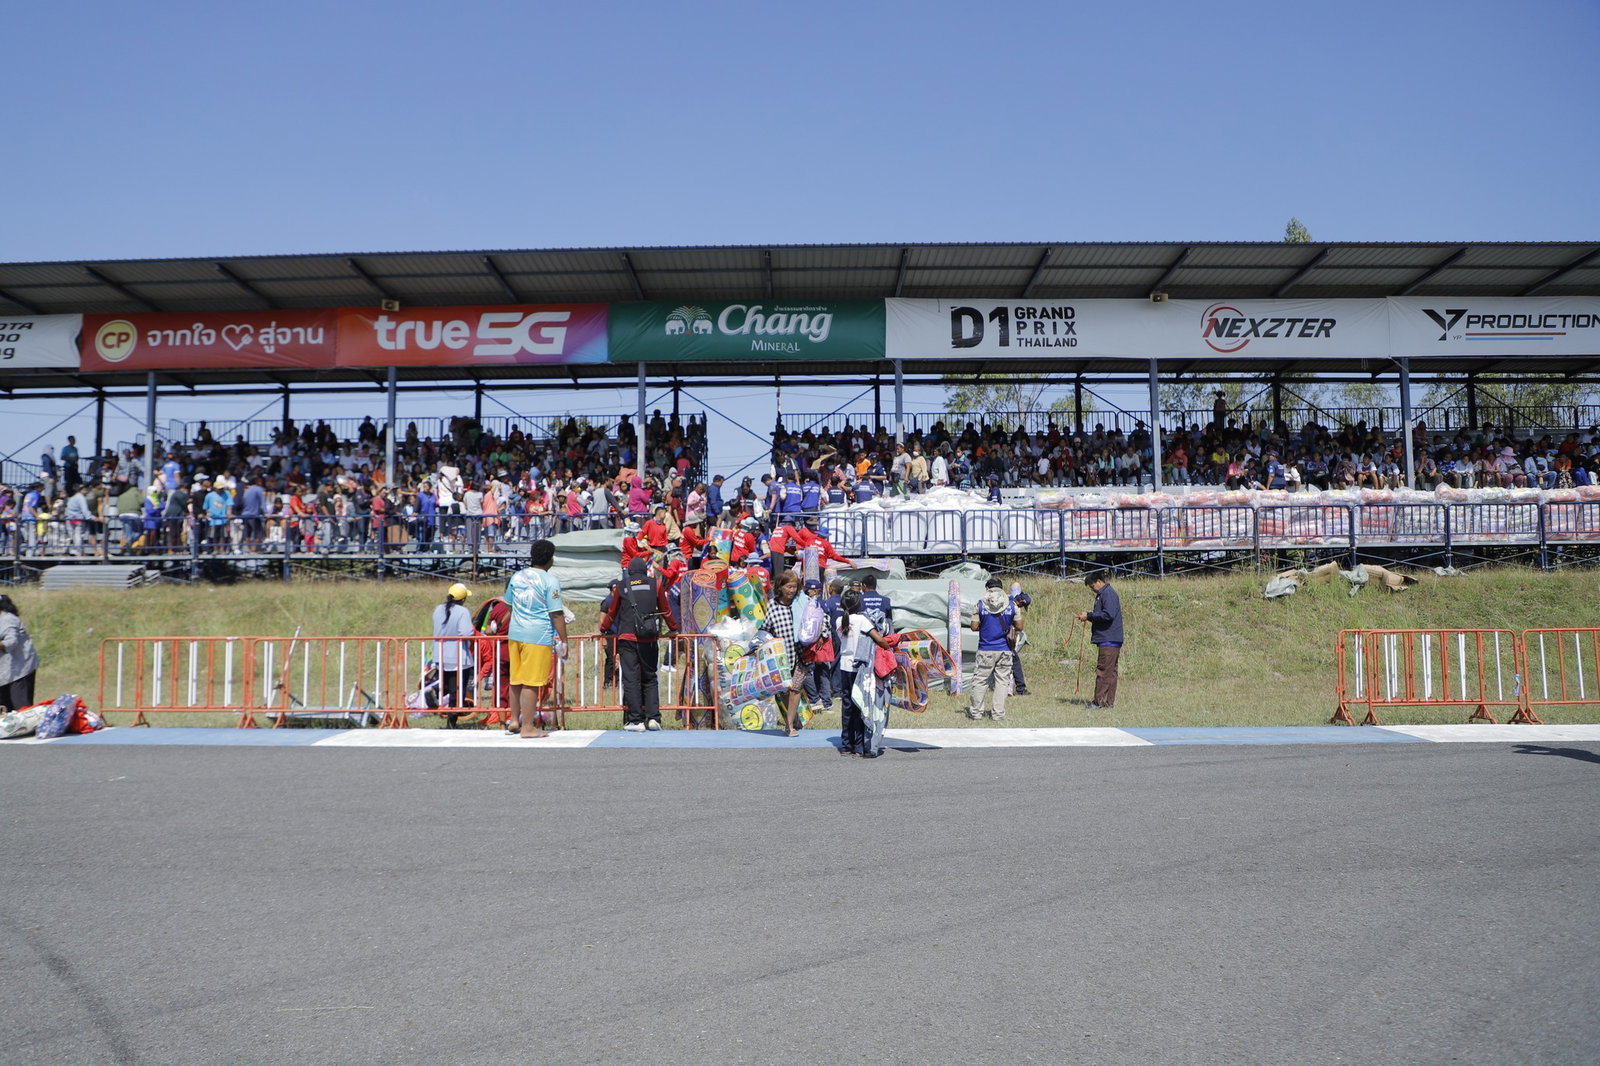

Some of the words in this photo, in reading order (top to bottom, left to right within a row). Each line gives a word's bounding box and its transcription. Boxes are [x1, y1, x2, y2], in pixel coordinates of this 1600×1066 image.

[1014, 307, 1076, 320] GRAND
[717, 304, 834, 343] Chang
[951, 306, 1009, 348] D1
[1016, 321, 1077, 335] PRIX
[1202, 318, 1337, 338] NEXZTER
[101, 331, 131, 349] CP
[146, 322, 217, 347] จากใจ
[258, 320, 324, 354] สู่จาน
[373, 315, 470, 350] true
[473, 311, 571, 356] 5G
[1016, 338, 1078, 347] THAILAND
[751, 340, 801, 353] MINERAL
